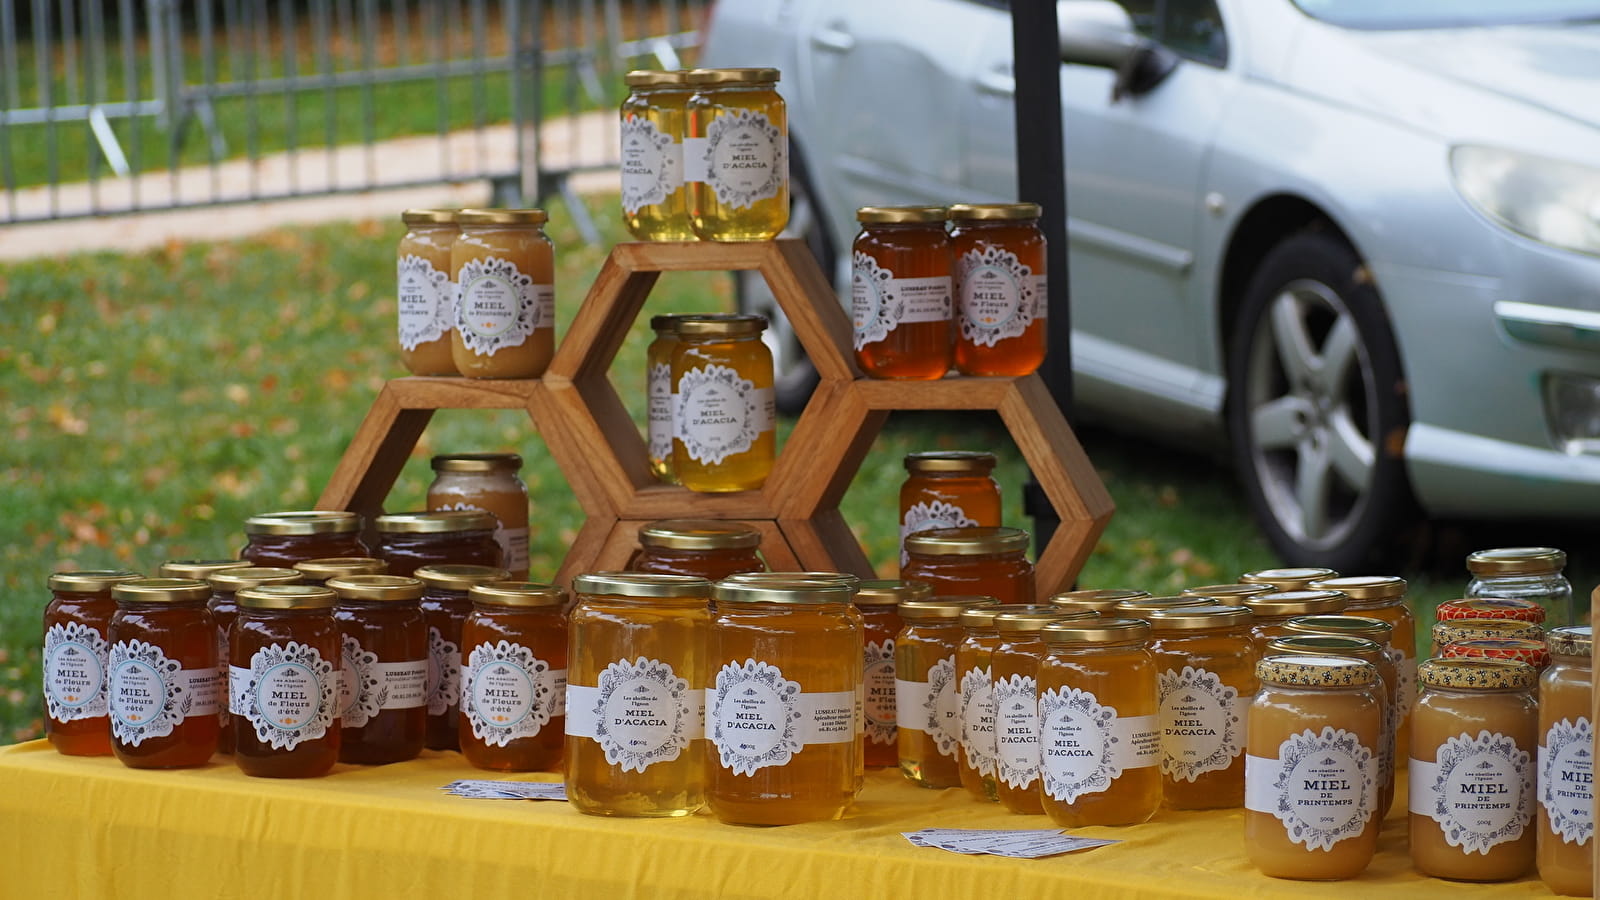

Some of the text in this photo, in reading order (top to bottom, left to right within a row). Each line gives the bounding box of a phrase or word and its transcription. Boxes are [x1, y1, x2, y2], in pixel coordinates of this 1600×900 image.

[974, 292, 1006, 300] MIEL
[474, 302, 505, 310] MIEL
[700, 410, 727, 418] MIEL
[692, 417, 738, 425] D'ACACIA
[57, 669, 87, 678] MIEL
[120, 688, 150, 697] MIEL
[271, 691, 307, 700] MIEL
[485, 688, 518, 698] MIEL
[871, 687, 896, 696] MIE
[126, 697, 154, 705] Fleurs
[280, 700, 310, 708] Fleurs
[492, 698, 522, 706] Fleurs
[125, 704, 144, 712] d'été
[490, 705, 512, 713] d'été
[625, 709, 655, 717] MIEL
[736, 712, 763, 721] MIEL
[614, 718, 668, 726] D'ACACIA
[727, 721, 776, 731] D'ACACIA
[1174, 719, 1203, 727] MIEL
[1007, 727, 1032, 735] MIEL
[1165, 728, 1217, 736] D'ACACIA
[1001, 736, 1038, 744] D'ACACI
[1054, 740, 1080, 748] MIEL
[1047, 749, 1094, 757] D'ACACIA
[1561, 770, 1593, 783] MIE
[1303, 780, 1351, 791] MIEL
[1460, 783, 1509, 794] MIEL
